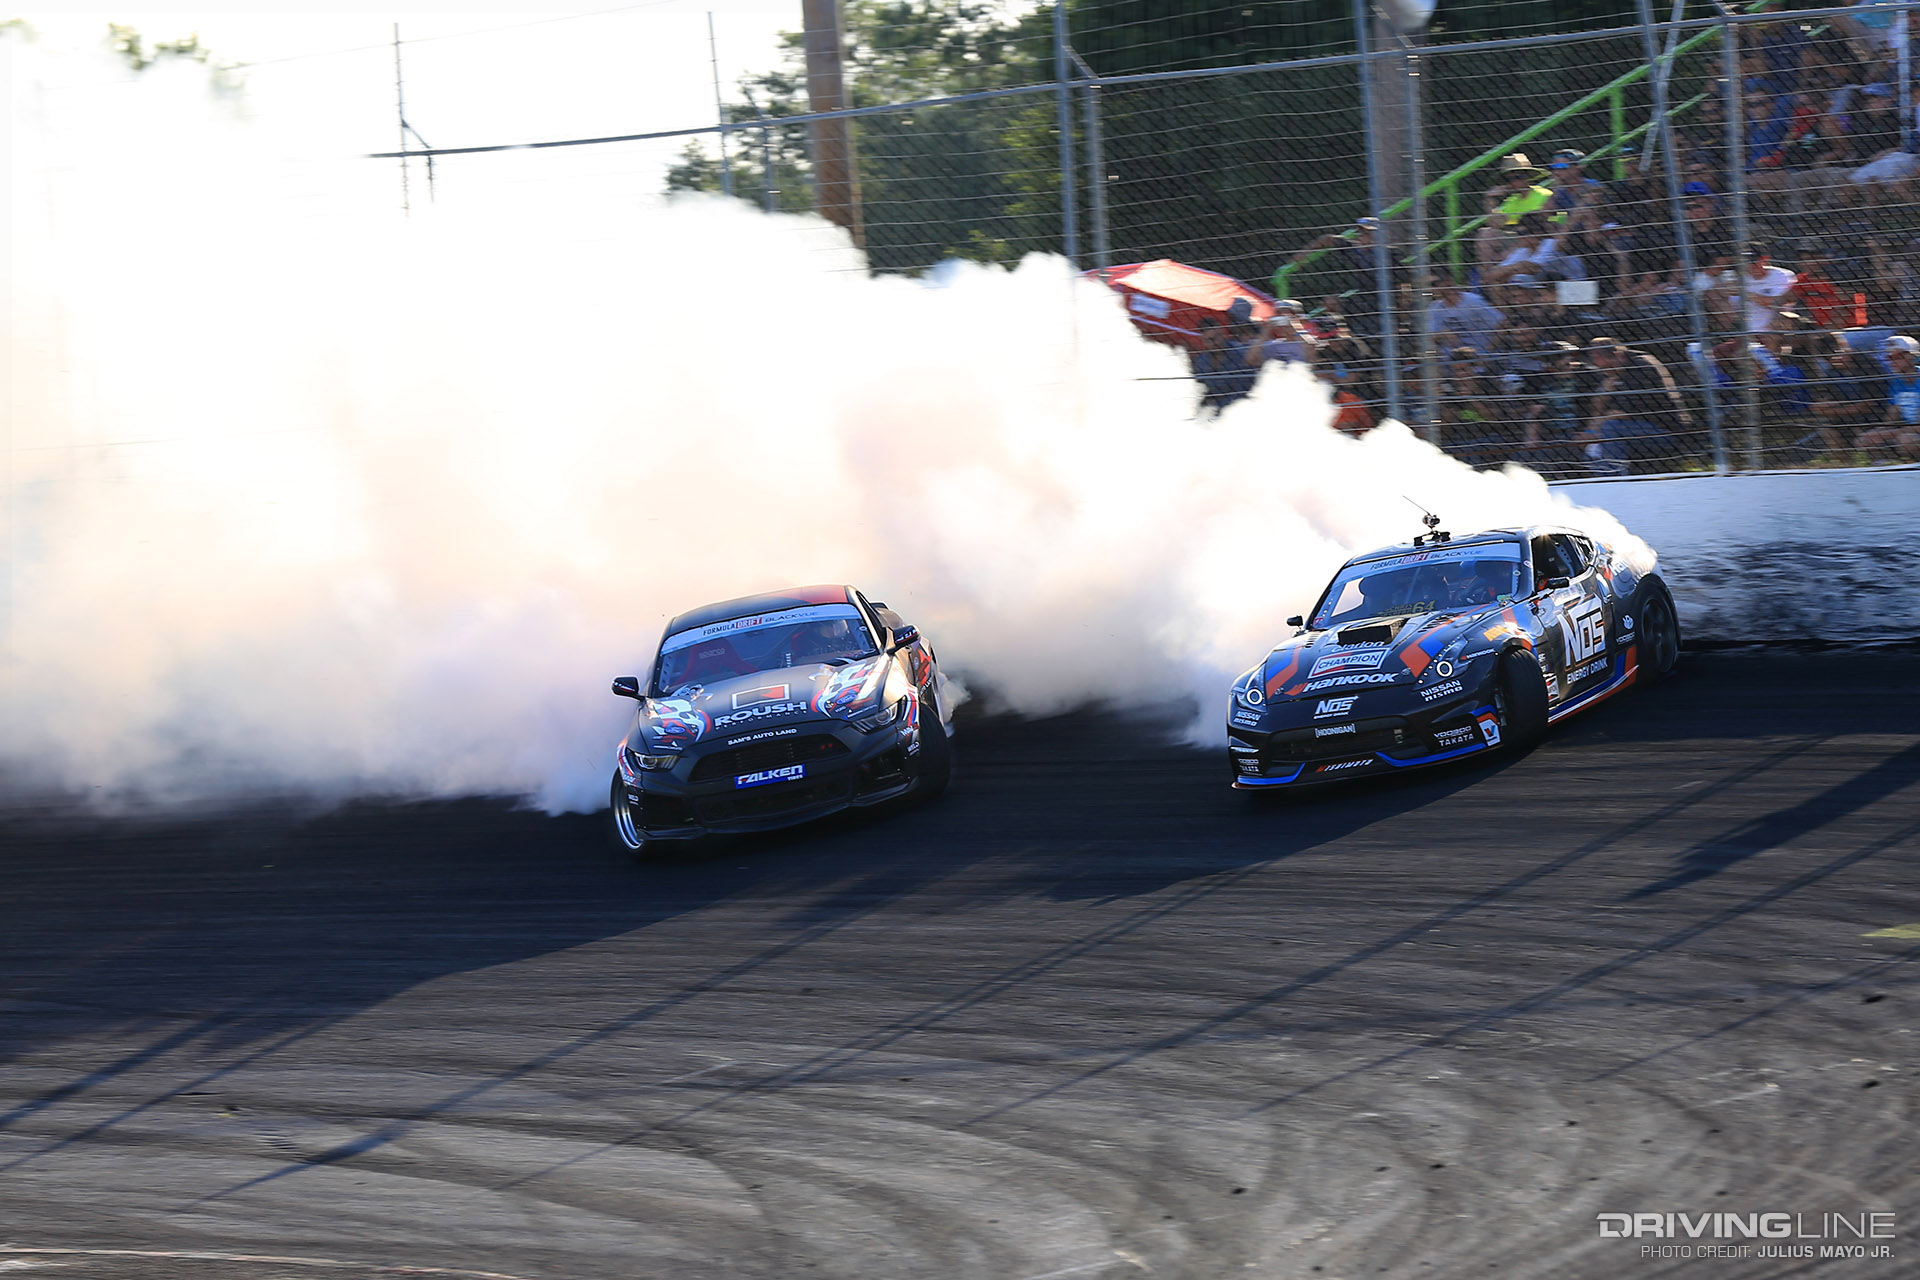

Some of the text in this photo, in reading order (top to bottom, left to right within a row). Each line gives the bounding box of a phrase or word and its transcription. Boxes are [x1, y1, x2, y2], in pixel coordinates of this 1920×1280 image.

[1370, 553, 1430, 570] FORMULA DRIFT
[1431, 550, 1481, 560] BLACKVUE
[1413, 600, 1436, 613] 64
[764, 611, 818, 623] BLACKVUE
[702, 617, 762, 636] FORMULA DRIFT
[1557, 594, 1607, 668] NOS
[1318, 654, 1378, 670] CHAMPION
[1567, 657, 1608, 685] ENERGY DRINK
[1420, 680, 1462, 697] NISSAN
[1314, 695, 1359, 715] NOS
[714, 701, 808, 727] ROUSH
[715, 710, 808, 730] PERFORMANCE
[1235, 711, 1262, 721] NISSAN
[727, 728, 798, 746] SAM'S AUTO LAND
[1438, 733, 1475, 746] TAKATA
[737, 764, 804, 785] FALKEN
